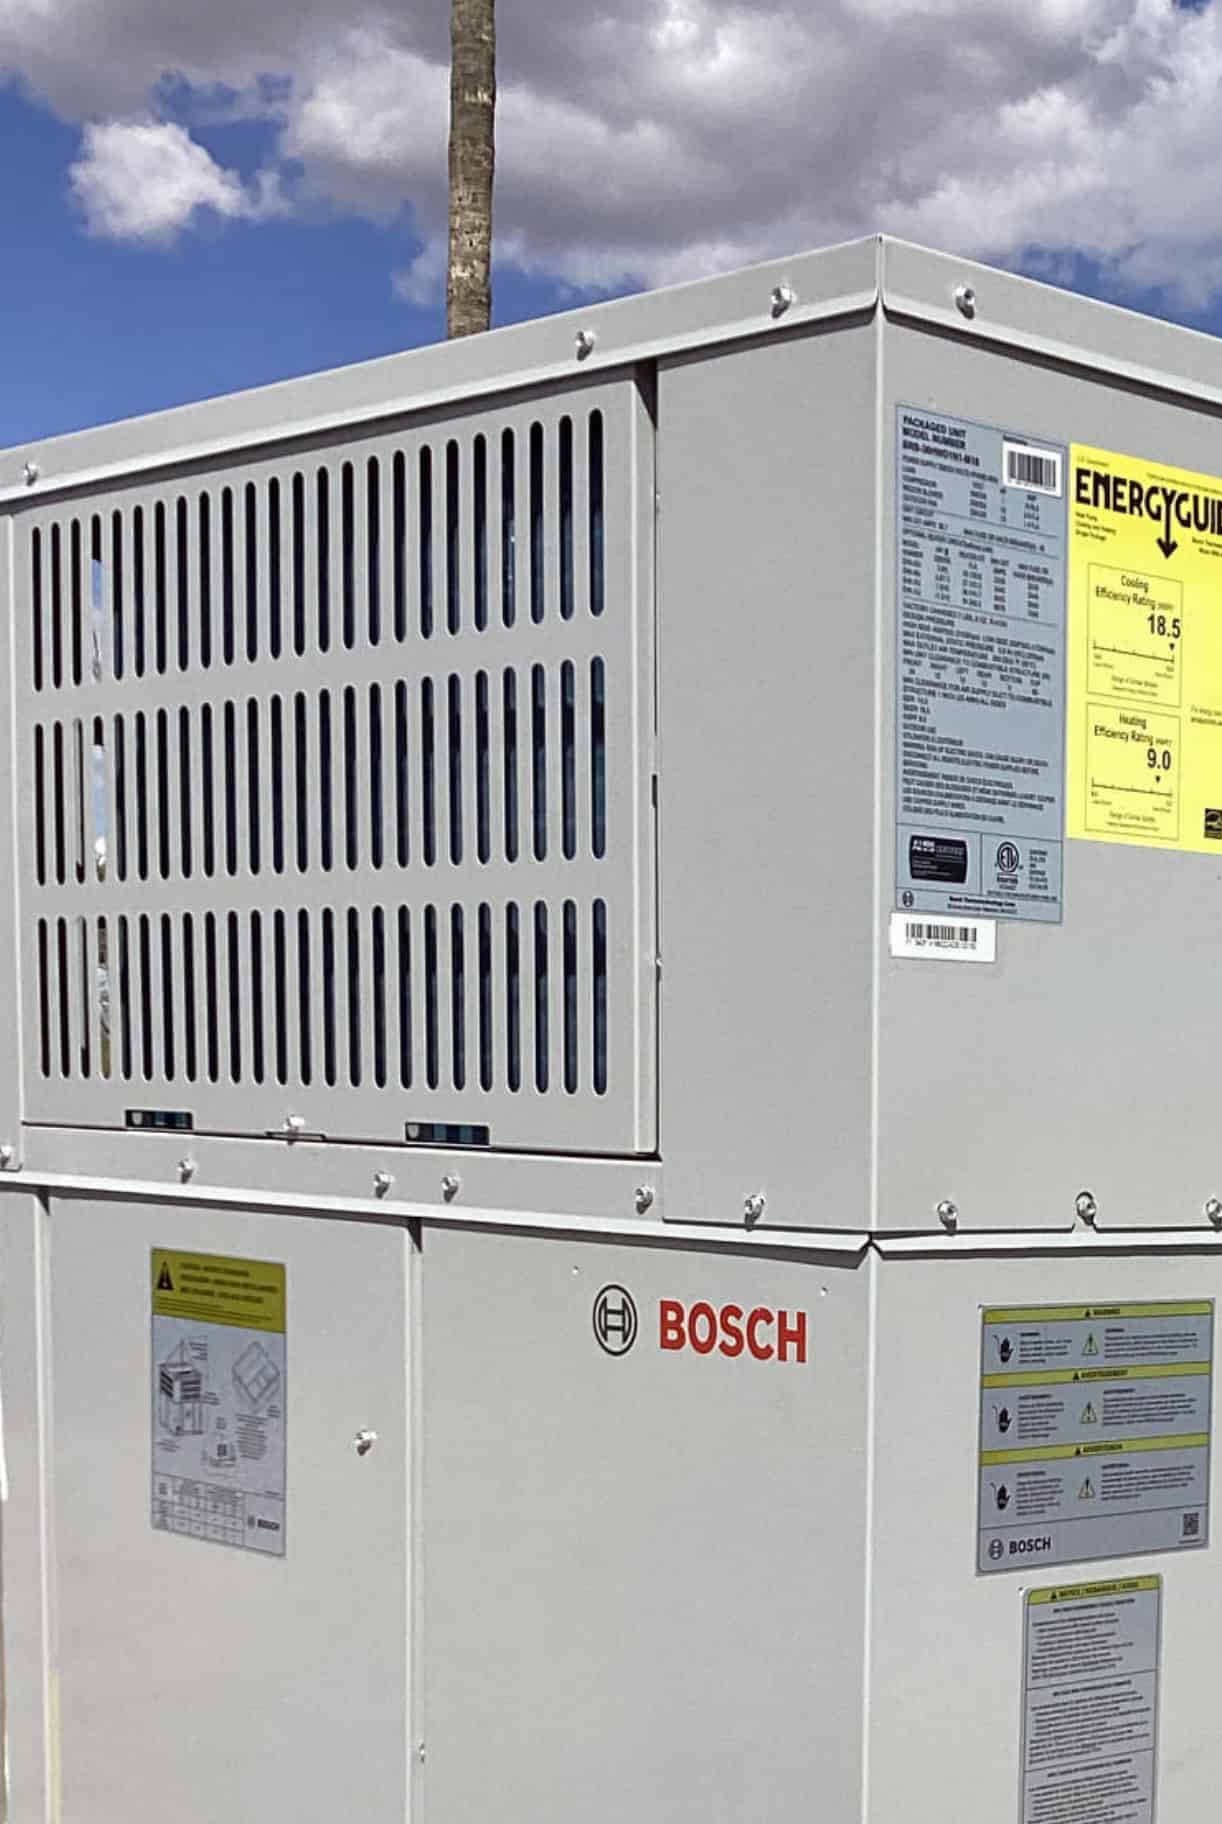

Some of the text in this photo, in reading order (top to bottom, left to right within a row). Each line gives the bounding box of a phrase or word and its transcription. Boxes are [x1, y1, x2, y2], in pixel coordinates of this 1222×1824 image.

[1121, 575, 1149, 593] Cooling
[1095, 586, 1131, 606] Efficiency
[1133, 593, 1156, 611] Rating
[1148, 613, 1181, 639] 18.5
[1119, 712, 1147, 730] Heating
[1094, 724, 1129, 743] Efficiency
[1131, 730, 1154, 746] Rating
[1147, 748, 1172, 770] 9.0
[660, 1300, 806, 1363] BOSCH
[1009, 1536, 1051, 1555] BOSCH
